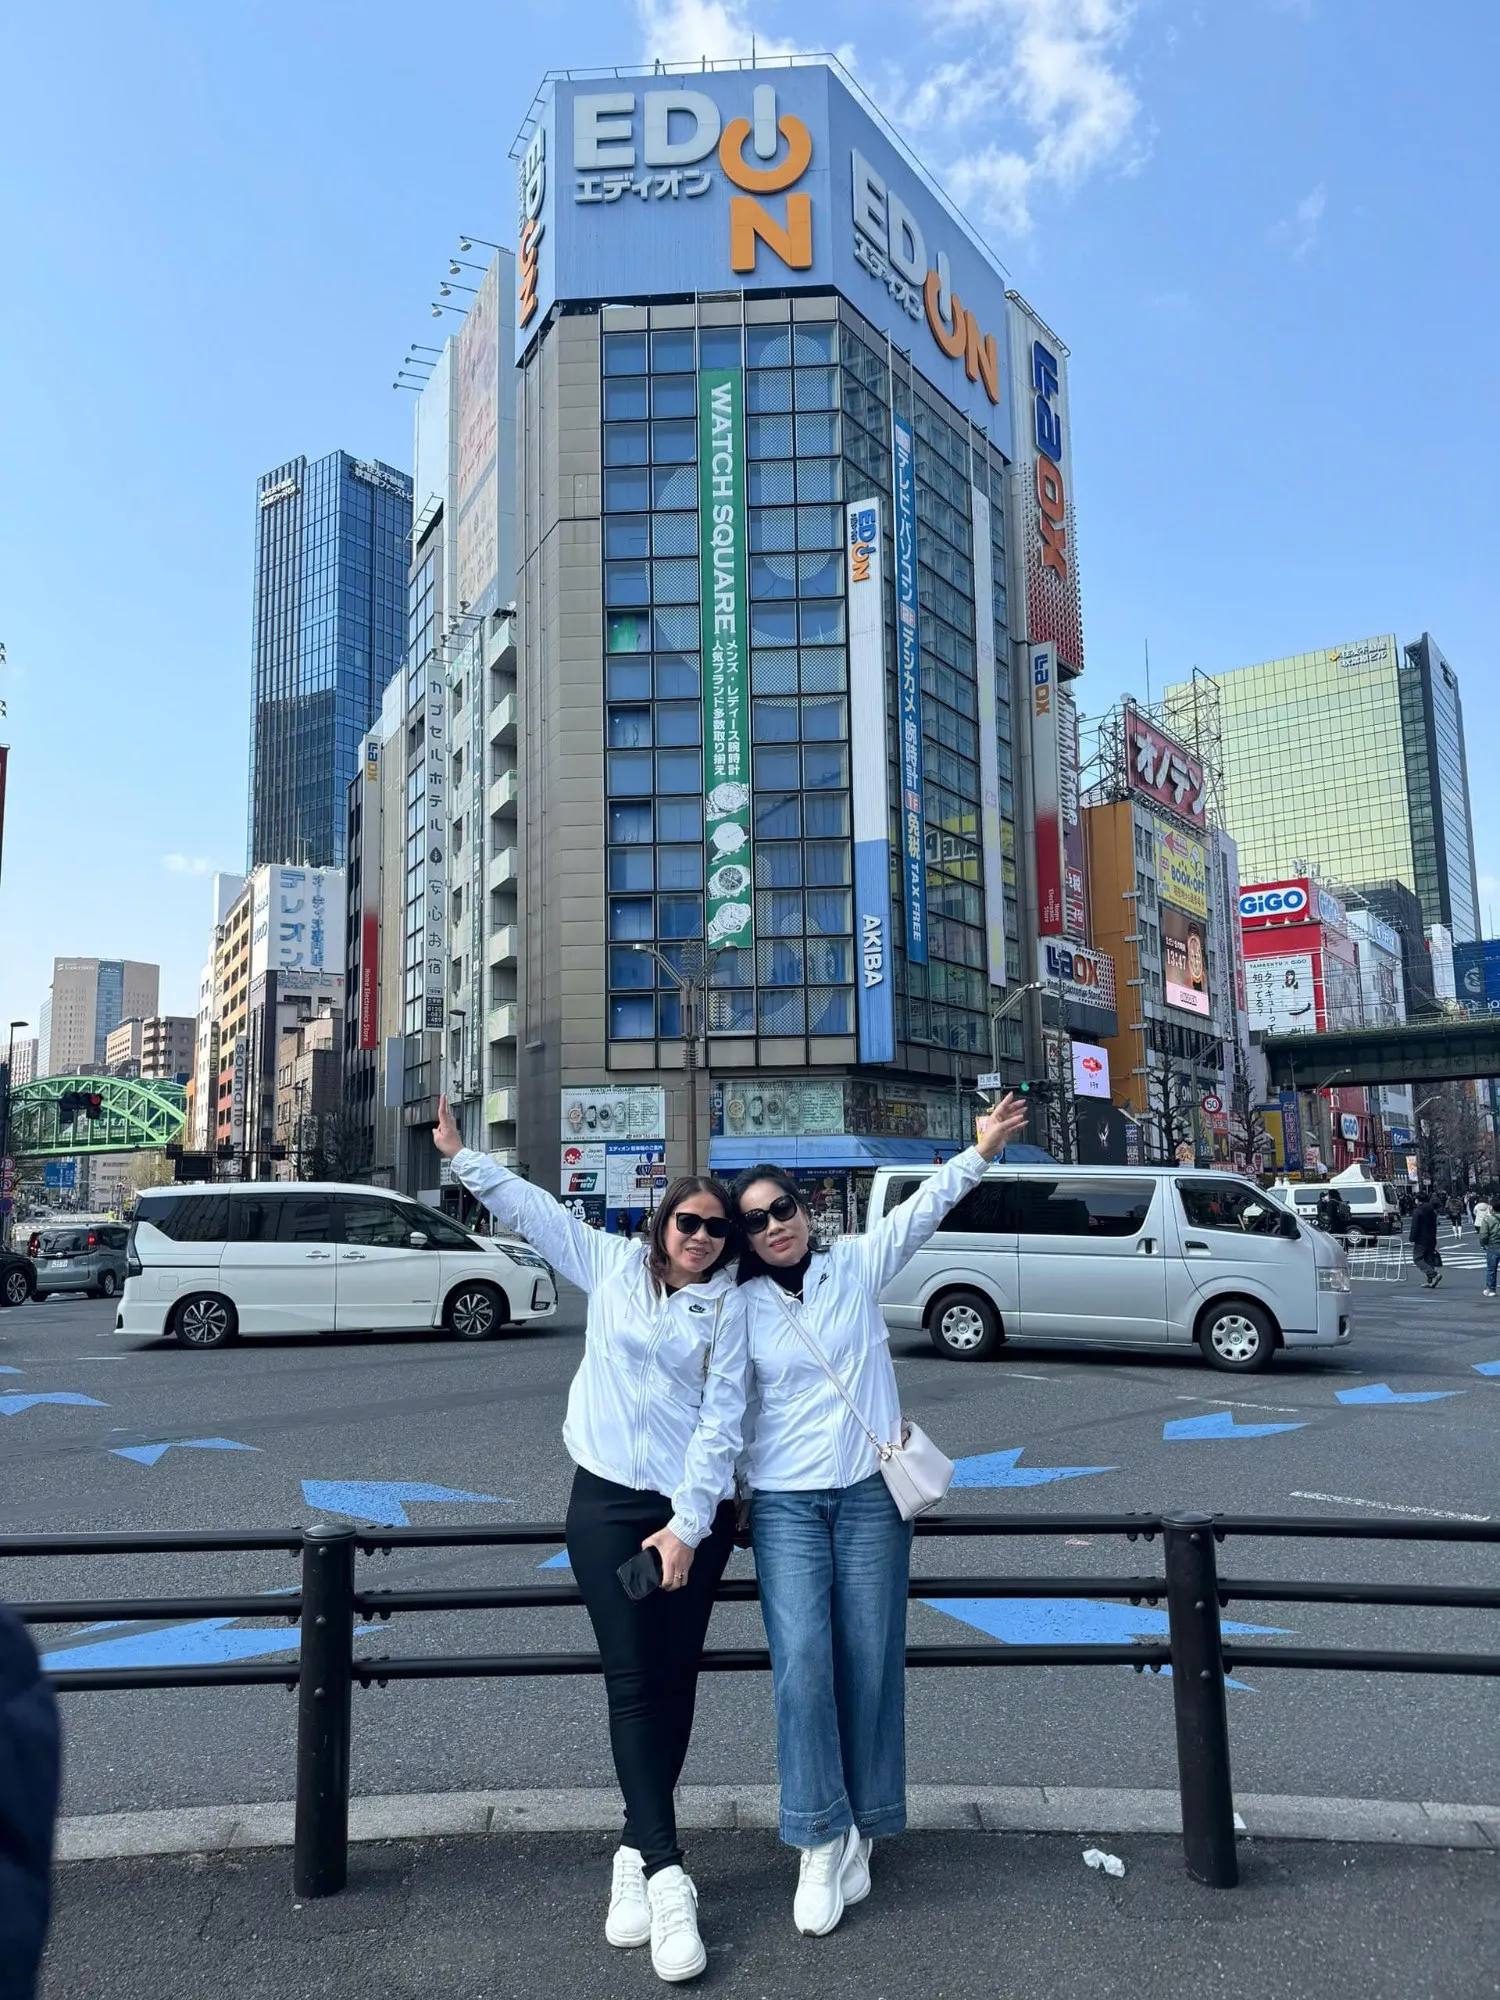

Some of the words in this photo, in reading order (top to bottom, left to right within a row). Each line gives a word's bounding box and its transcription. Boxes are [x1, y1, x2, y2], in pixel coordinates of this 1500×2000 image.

[573, 84, 812, 273] EDION
[574, 170, 712, 203] エディオン
[852, 149, 1000, 404] EDION
[853, 232, 924, 321] エディオン
[711, 381, 733, 498] WATCH
[710, 504, 736, 635] SQUARE
[851, 508, 876, 582] EDION
[711, 639, 726, 776] 人気ブランド多数取り揃え
[726, 639, 741, 776] メンズ・レディース腕時計
[429, 680, 444, 832] カプセルホテル
[1134, 731, 1206, 815] オノデン
[909, 862, 920, 900] TAX
[911, 900, 922, 942] FREE
[1239, 890, 1303, 915] GiGO
[428, 880, 443, 974] 安心お宿
[862, 914, 884, 989] AKIBA
[1167, 948, 1187, 971] 13:47
[1206, 1100, 1218, 1109] 50
